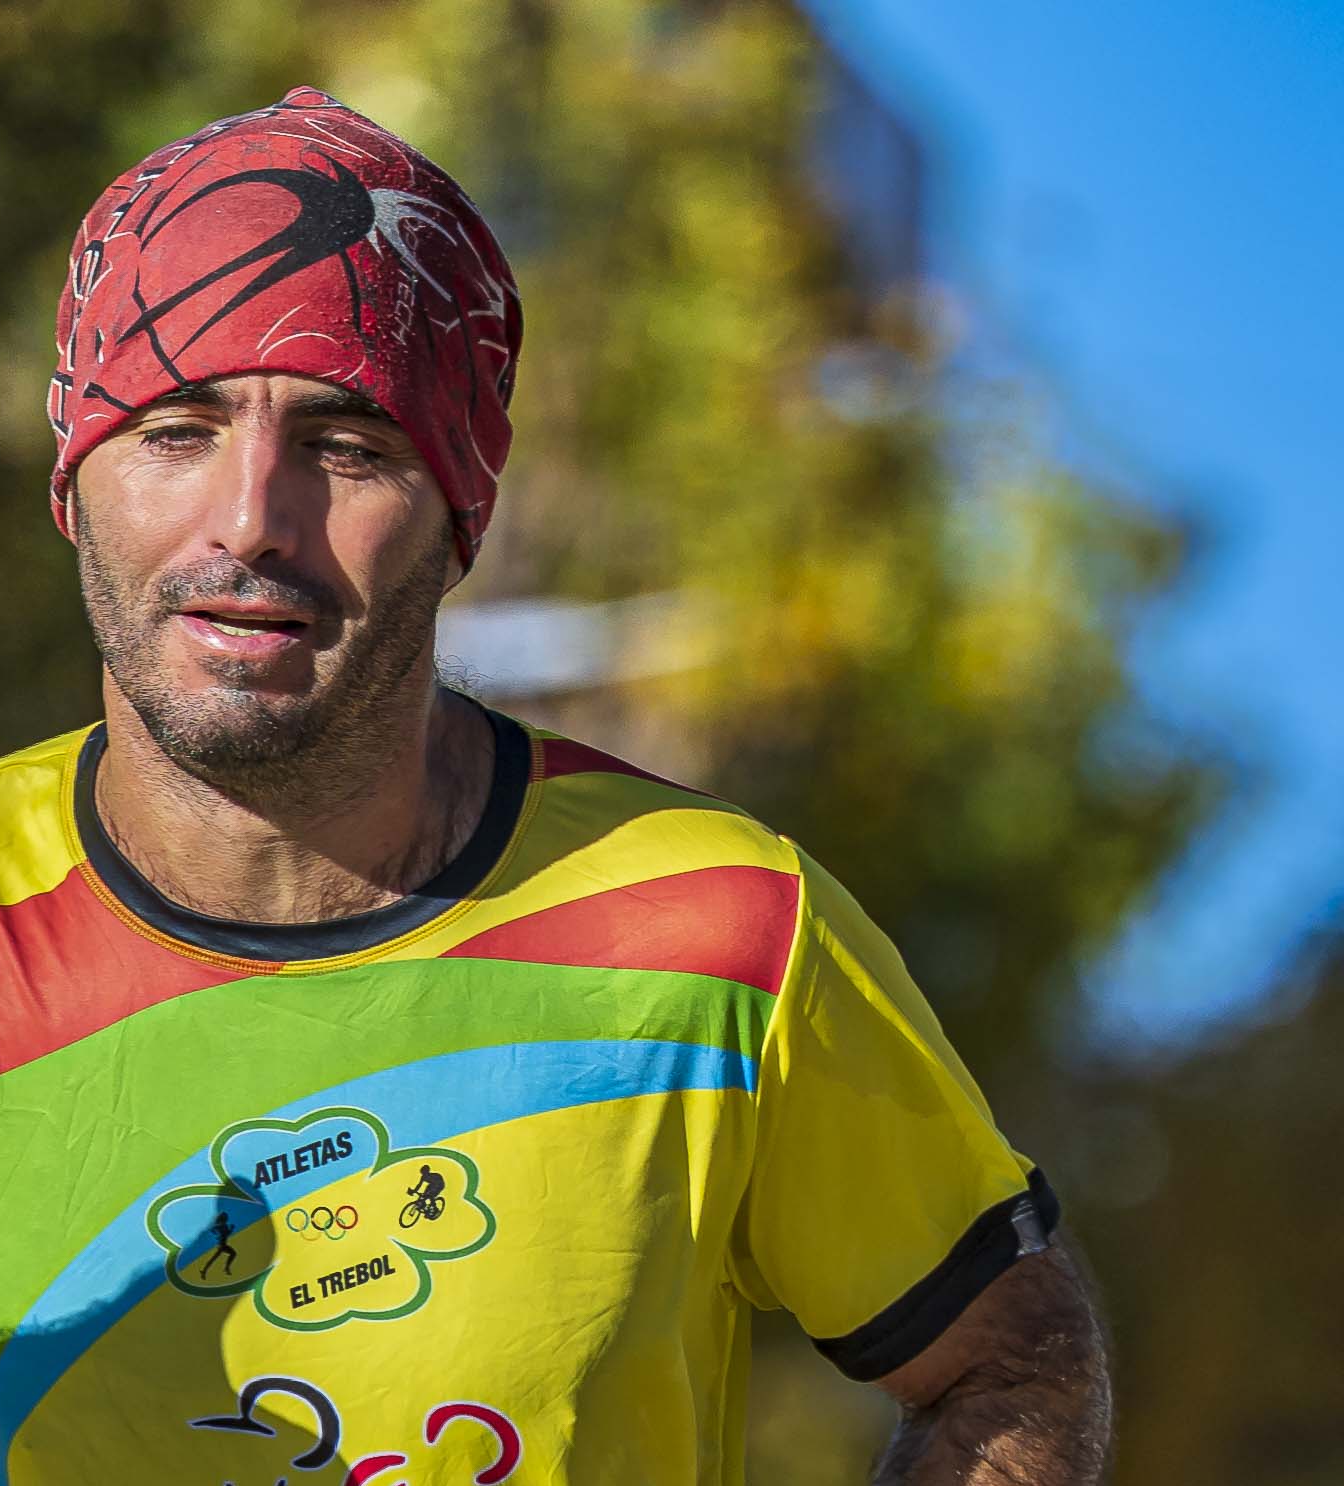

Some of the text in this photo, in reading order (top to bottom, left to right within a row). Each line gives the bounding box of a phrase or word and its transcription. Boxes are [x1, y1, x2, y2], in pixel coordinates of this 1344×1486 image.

[254, 1131, 353, 1189] ATLETAS
[290, 1254, 396, 1309] EL TREBOL
